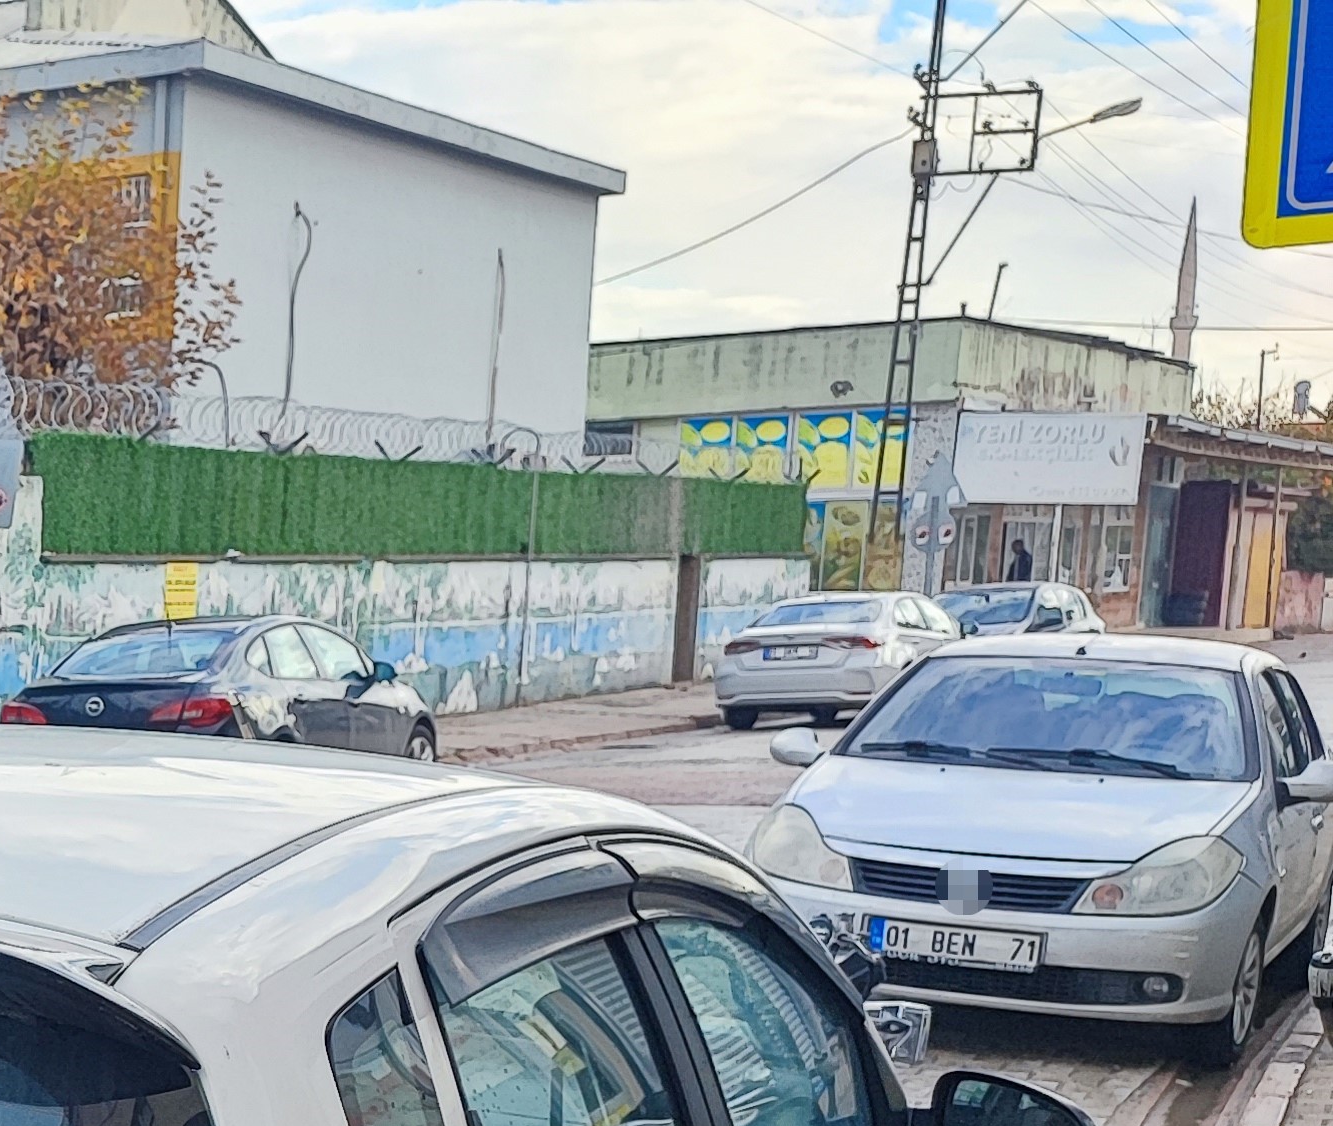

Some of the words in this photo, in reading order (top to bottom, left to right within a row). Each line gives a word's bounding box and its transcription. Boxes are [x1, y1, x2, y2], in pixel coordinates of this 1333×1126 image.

[886, 925, 910, 949] 01
[931, 930, 977, 956] BEN
[1010, 938, 1036, 962] 71
